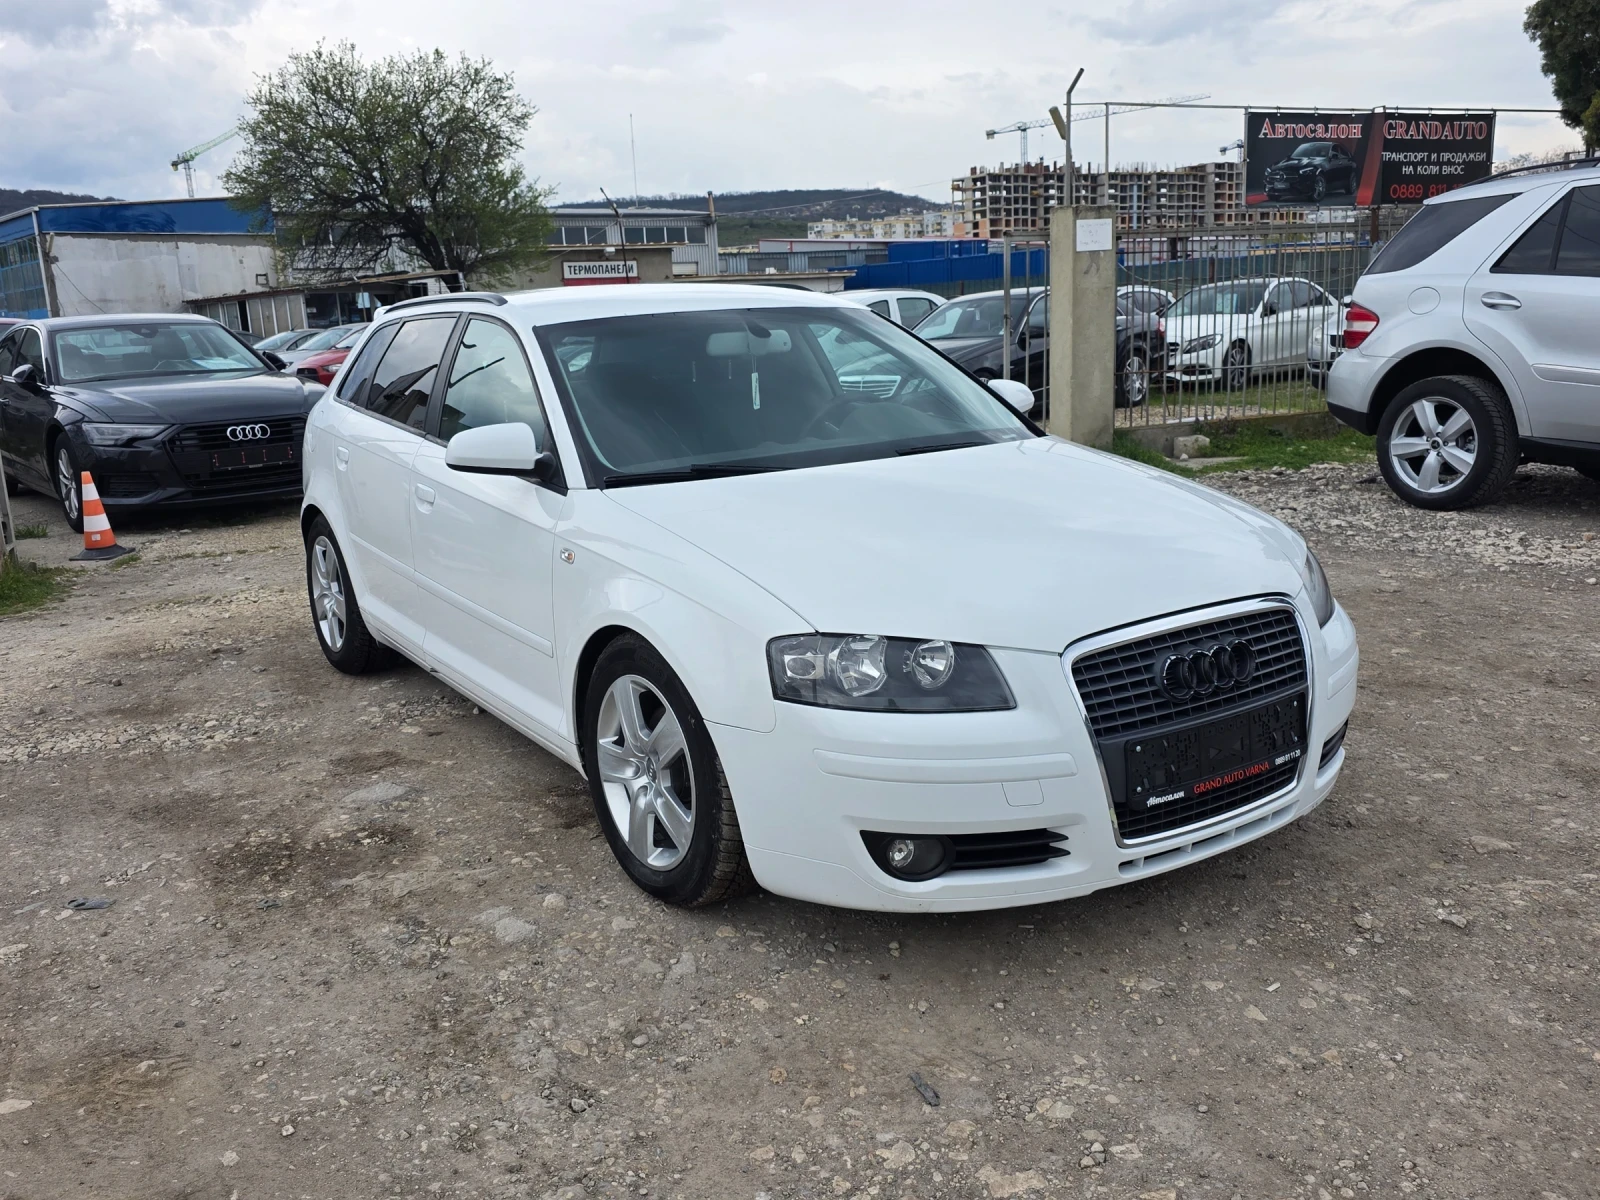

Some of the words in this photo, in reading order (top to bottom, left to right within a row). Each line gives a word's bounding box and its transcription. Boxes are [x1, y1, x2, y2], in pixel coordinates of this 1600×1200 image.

[1258, 117, 1363, 139] Автосалон
[1382, 119, 1488, 140] GRANDAUTO
[1381, 151, 1429, 162] ТРАНСПОРТ
[1431, 152, 1438, 162] И
[1440, 152, 1487, 164] ПРОДАЖБИ
[1402, 165, 1414, 175] НА
[1417, 165, 1440, 175] КОЛИ
[1442, 165, 1465, 175] ВНОС
[1390, 184, 1424, 199] 0889
[567, 264, 634, 276] ТЕРМОПАНЕЛИ
[1194, 777, 1222, 795] GRAND
[1223, 770, 1245, 786] AUTO
[1245, 761, 1270, 777] VARNA
